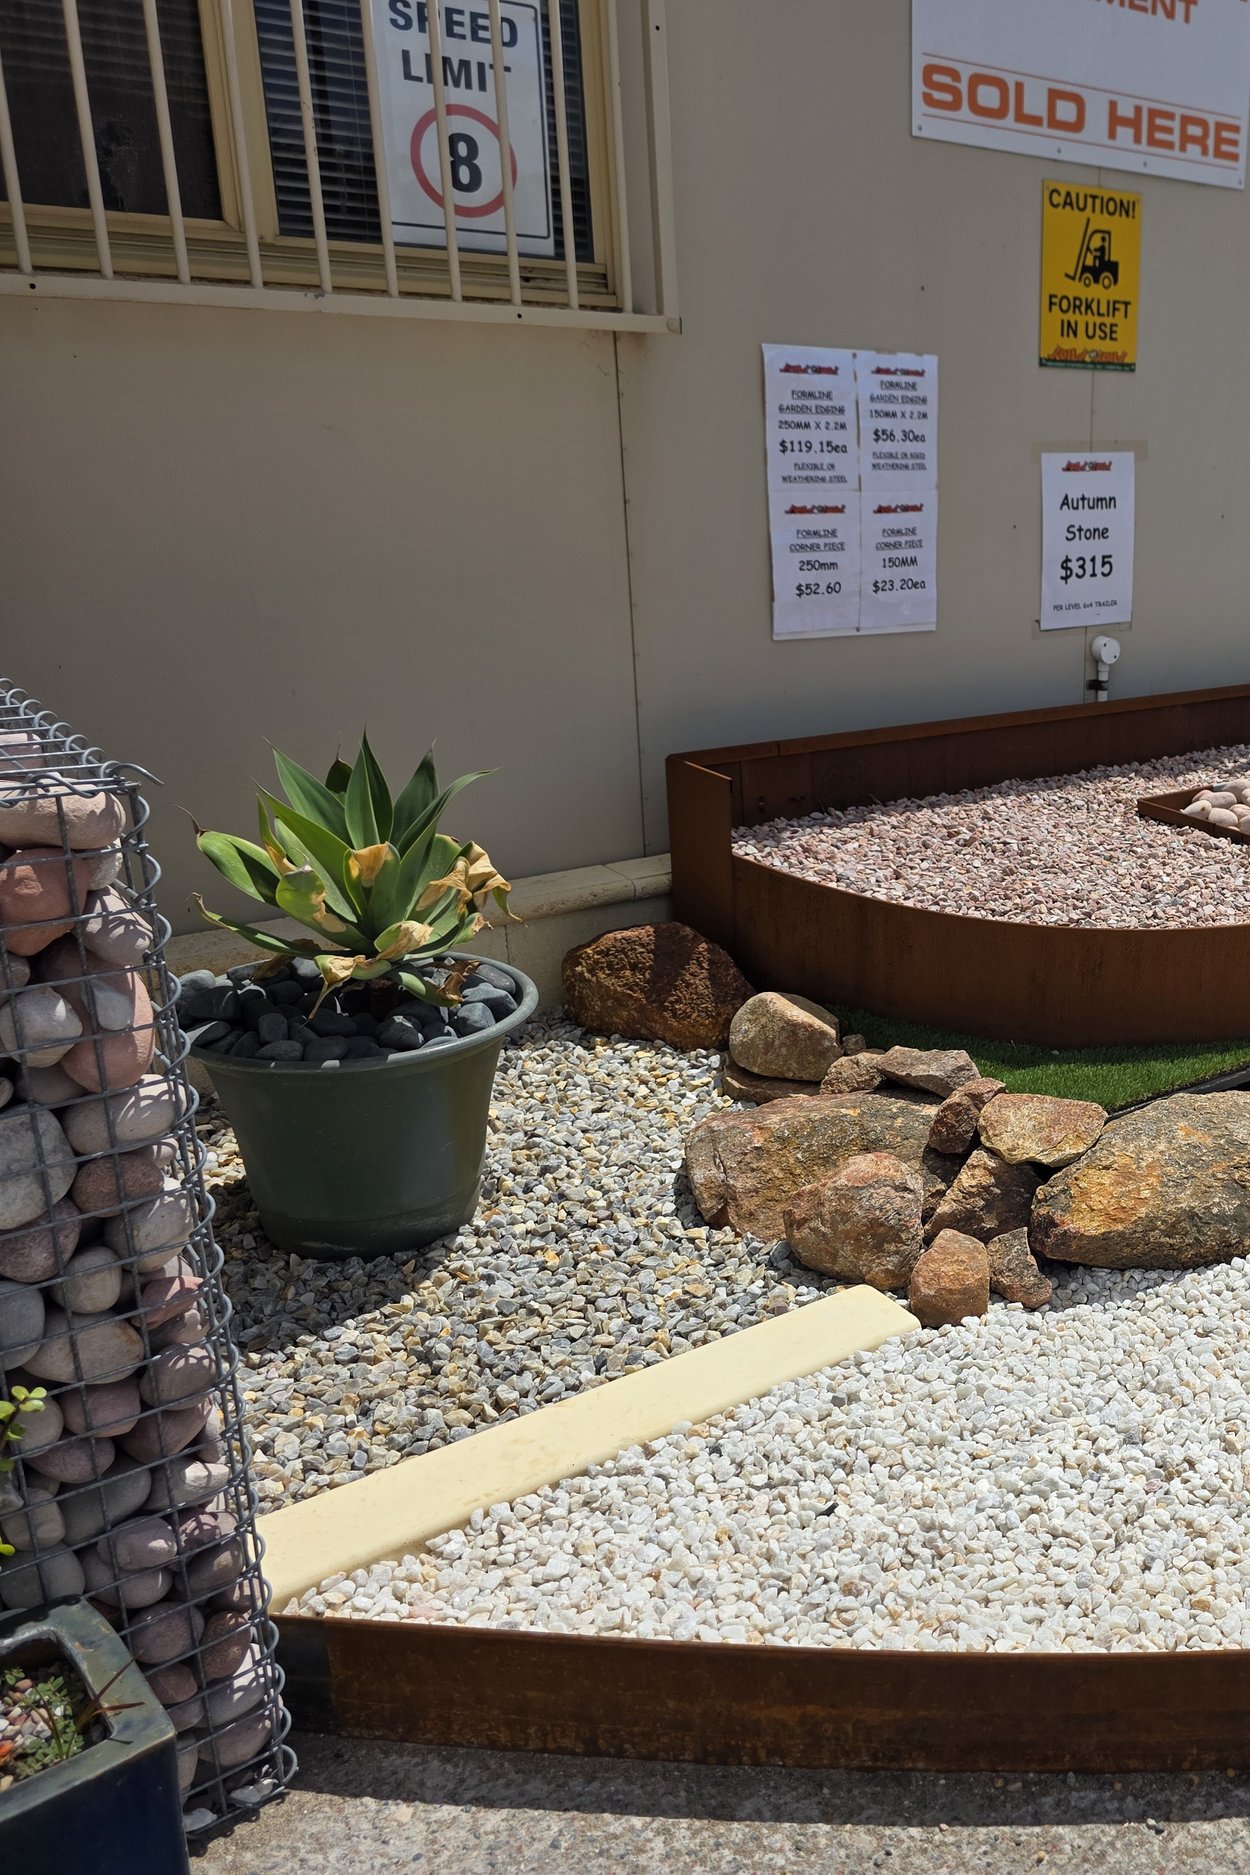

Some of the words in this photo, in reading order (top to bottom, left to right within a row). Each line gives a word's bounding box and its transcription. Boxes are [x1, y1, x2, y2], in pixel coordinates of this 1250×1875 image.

[922, 63, 1086, 134] SOLD
[1108, 100, 1241, 163] HERE
[448, 132, 483, 193] 8
[1048, 188, 1136, 219] CAUTION!
[1048, 294, 1132, 320] FORKLIFT
[1060, 320, 1079, 340] IN
[1084, 322, 1119, 342] USE
[880, 379, 917, 391] FORMLINE
[791, 389, 833, 400] FORMLINE
[778, 404, 812, 415] GARDEN
[815, 405, 846, 416] EDGING
[869, 409, 898, 419] 150MM
[900, 410, 907, 420] X
[778, 420, 811, 430] 250MM
[814, 420, 822, 431] X
[824, 421, 847, 431] 2.2M
[873, 427, 926, 444] $56.30ea
[779, 438, 848, 455] $119.15ea
[1059, 493, 1117, 511] Autumn
[795, 528, 838, 539] FORMLINE
[882, 526, 917, 537] FORMLINE
[1065, 524, 1110, 542] Stone
[789, 542, 823, 553] CORNER
[824, 541, 846, 552] PIECE
[875, 540, 904, 551] CORNER
[905, 539, 923, 549] PIECE
[798, 559, 839, 571] 250mm
[881, 555, 918, 569] 150MM
[1060, 553, 1113, 585] $315
[795, 581, 842, 599] $52.60
[872, 577, 926, 595] $23.20ea
[1053, 604, 1064, 612] PER
[1065, 603, 1081, 611] LEVEL
[1094, 599, 1118, 608] TRAILER
